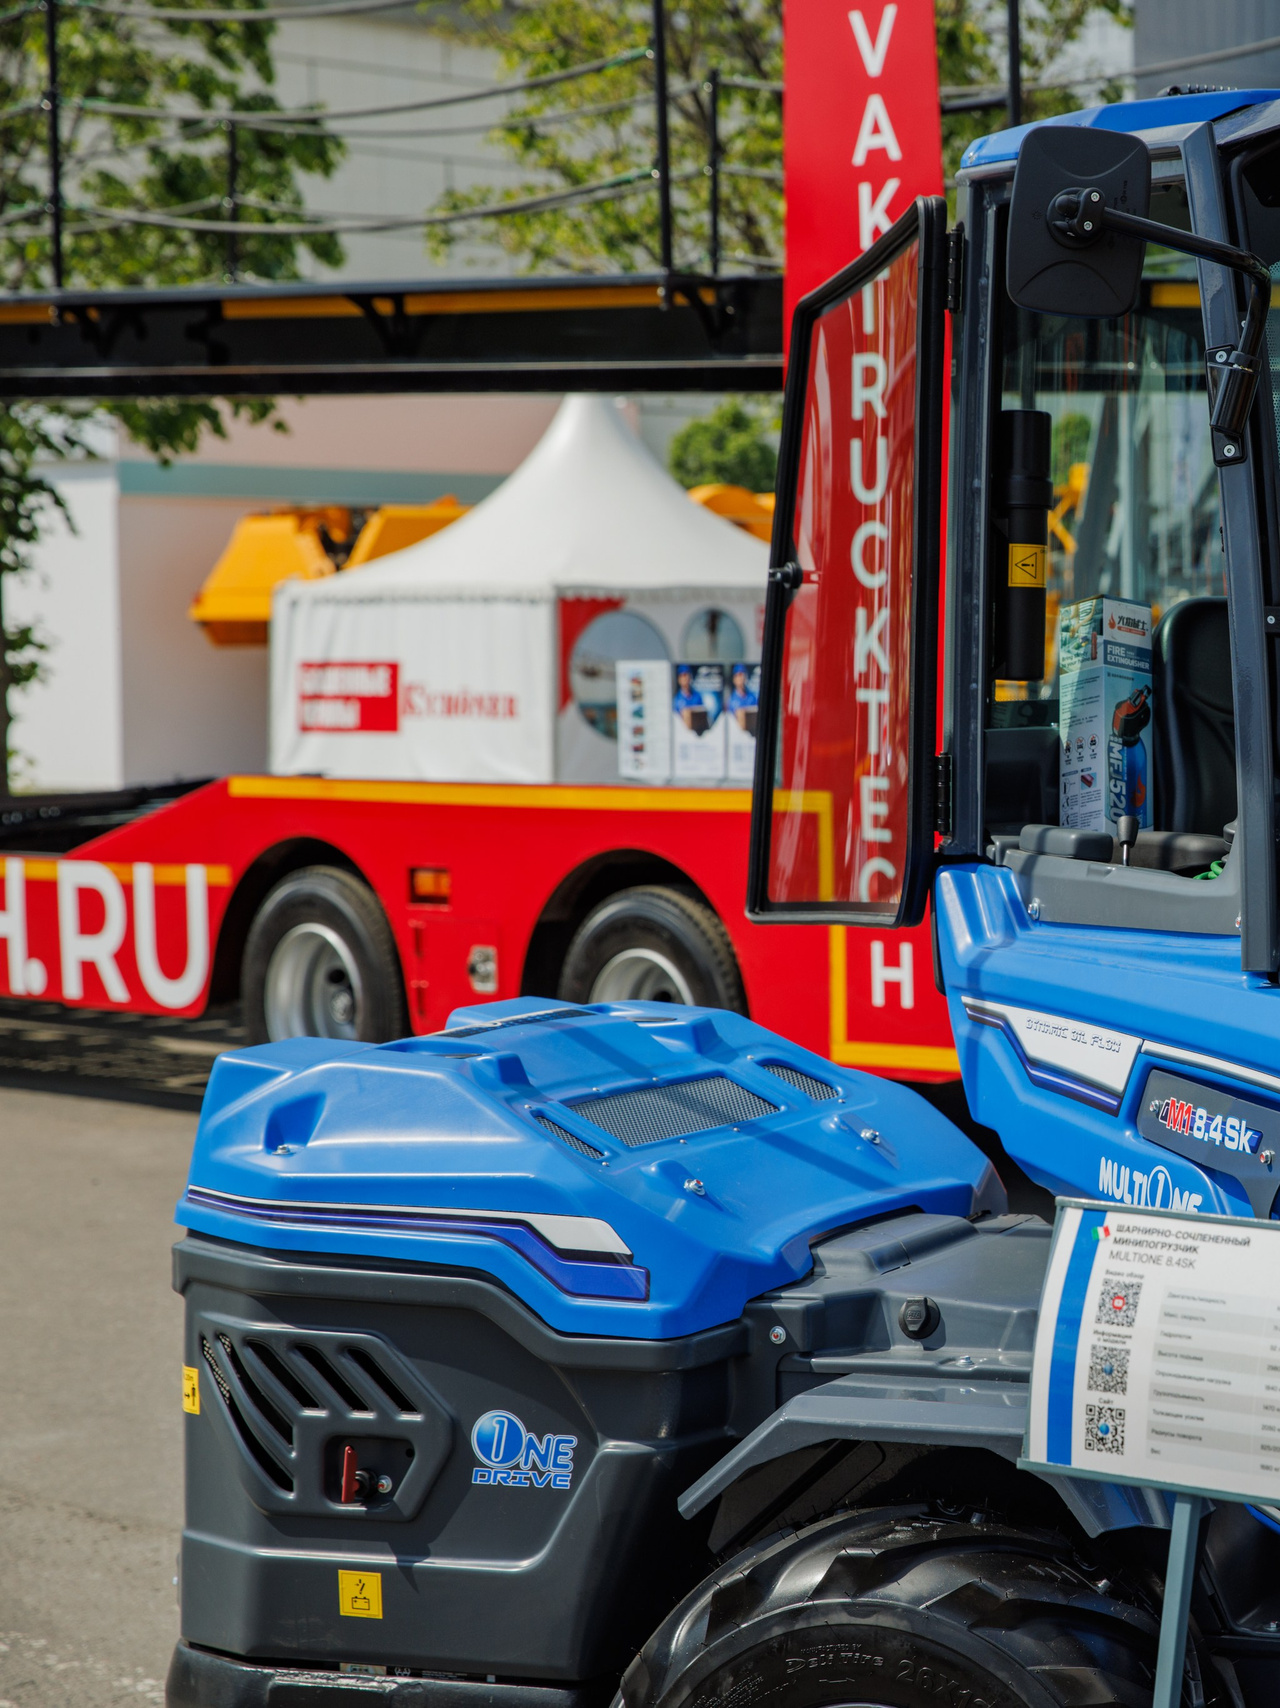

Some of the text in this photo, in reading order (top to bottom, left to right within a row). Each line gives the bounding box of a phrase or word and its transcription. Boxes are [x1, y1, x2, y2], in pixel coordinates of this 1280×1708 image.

[1107, 644, 1126, 657] FIRE
[1107, 654, 1150, 670] EXTINGUISHER
[1025, 1016, 1122, 1053] DYNAMIC OIL FLOW
[1116, 1223, 1252, 1247] ШАРНИРНО-СОЧЛЕНЕННЫЙ
[1112, 1237, 1200, 1255] МИНИПОГРУЗЧИК
[1108, 1249, 1197, 1269] MULTIONE 8.4SK
[471, 1467, 573, 1490] DRIVE
